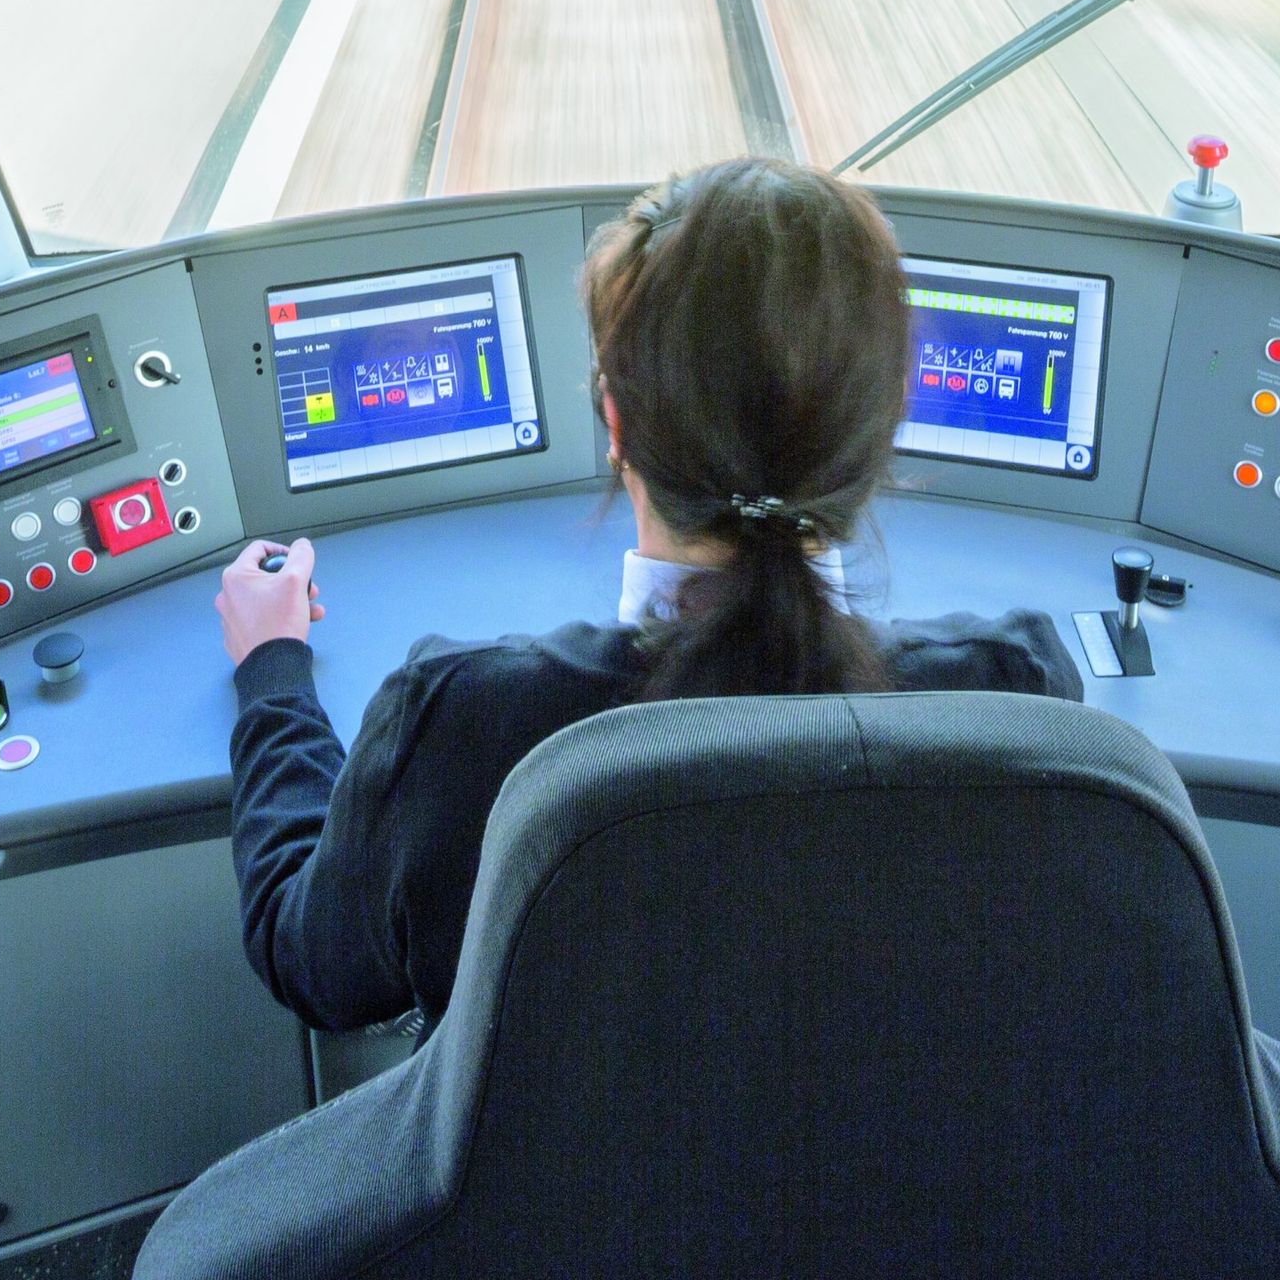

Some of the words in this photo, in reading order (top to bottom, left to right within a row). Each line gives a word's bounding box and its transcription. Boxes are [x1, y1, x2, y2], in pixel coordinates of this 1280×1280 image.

[278, 308, 288, 319] A
[472, 318, 486, 328] 760
[1048, 330, 1062, 340] 760
[303, 345, 313, 353] 14
